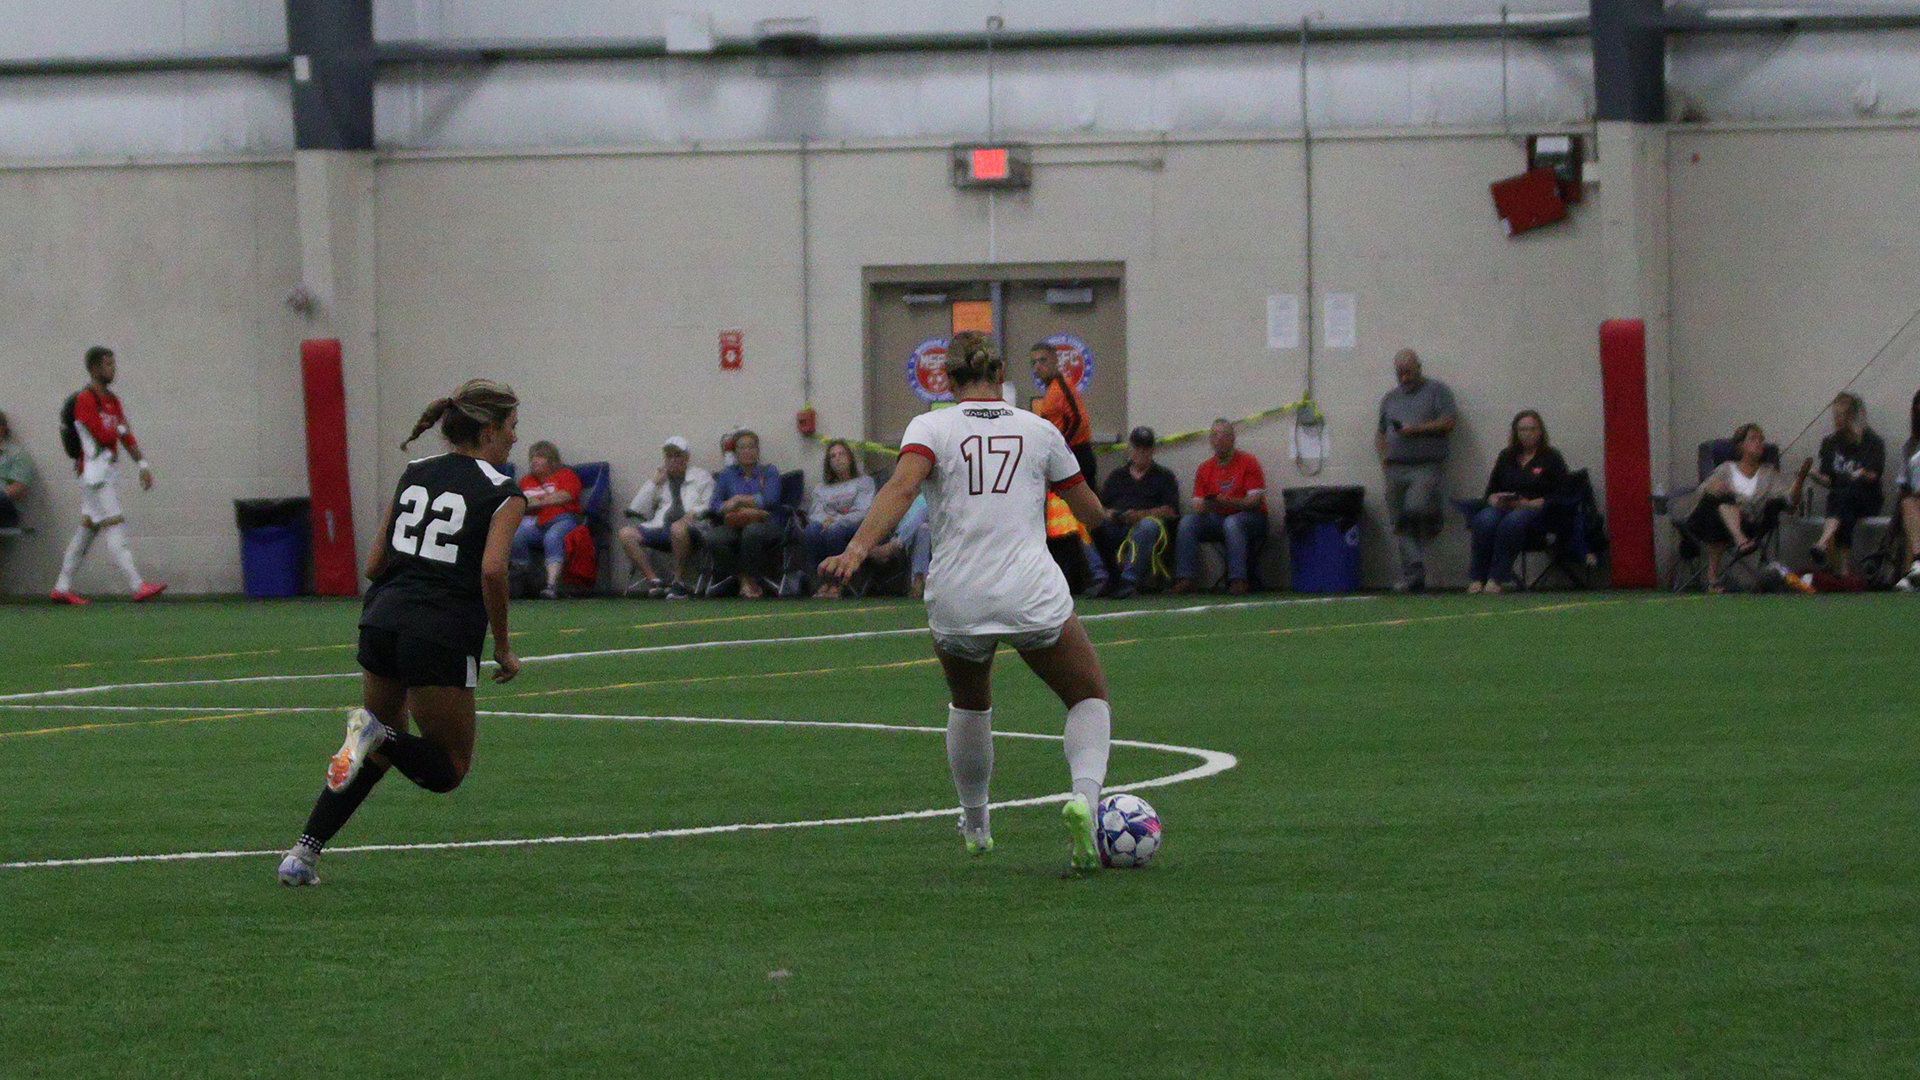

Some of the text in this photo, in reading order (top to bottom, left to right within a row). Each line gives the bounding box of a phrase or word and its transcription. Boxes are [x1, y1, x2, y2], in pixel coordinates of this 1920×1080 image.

[962, 408, 1014, 419] WARRIORS
[960, 435, 1023, 495] 17
[392, 485, 467, 564] 22
